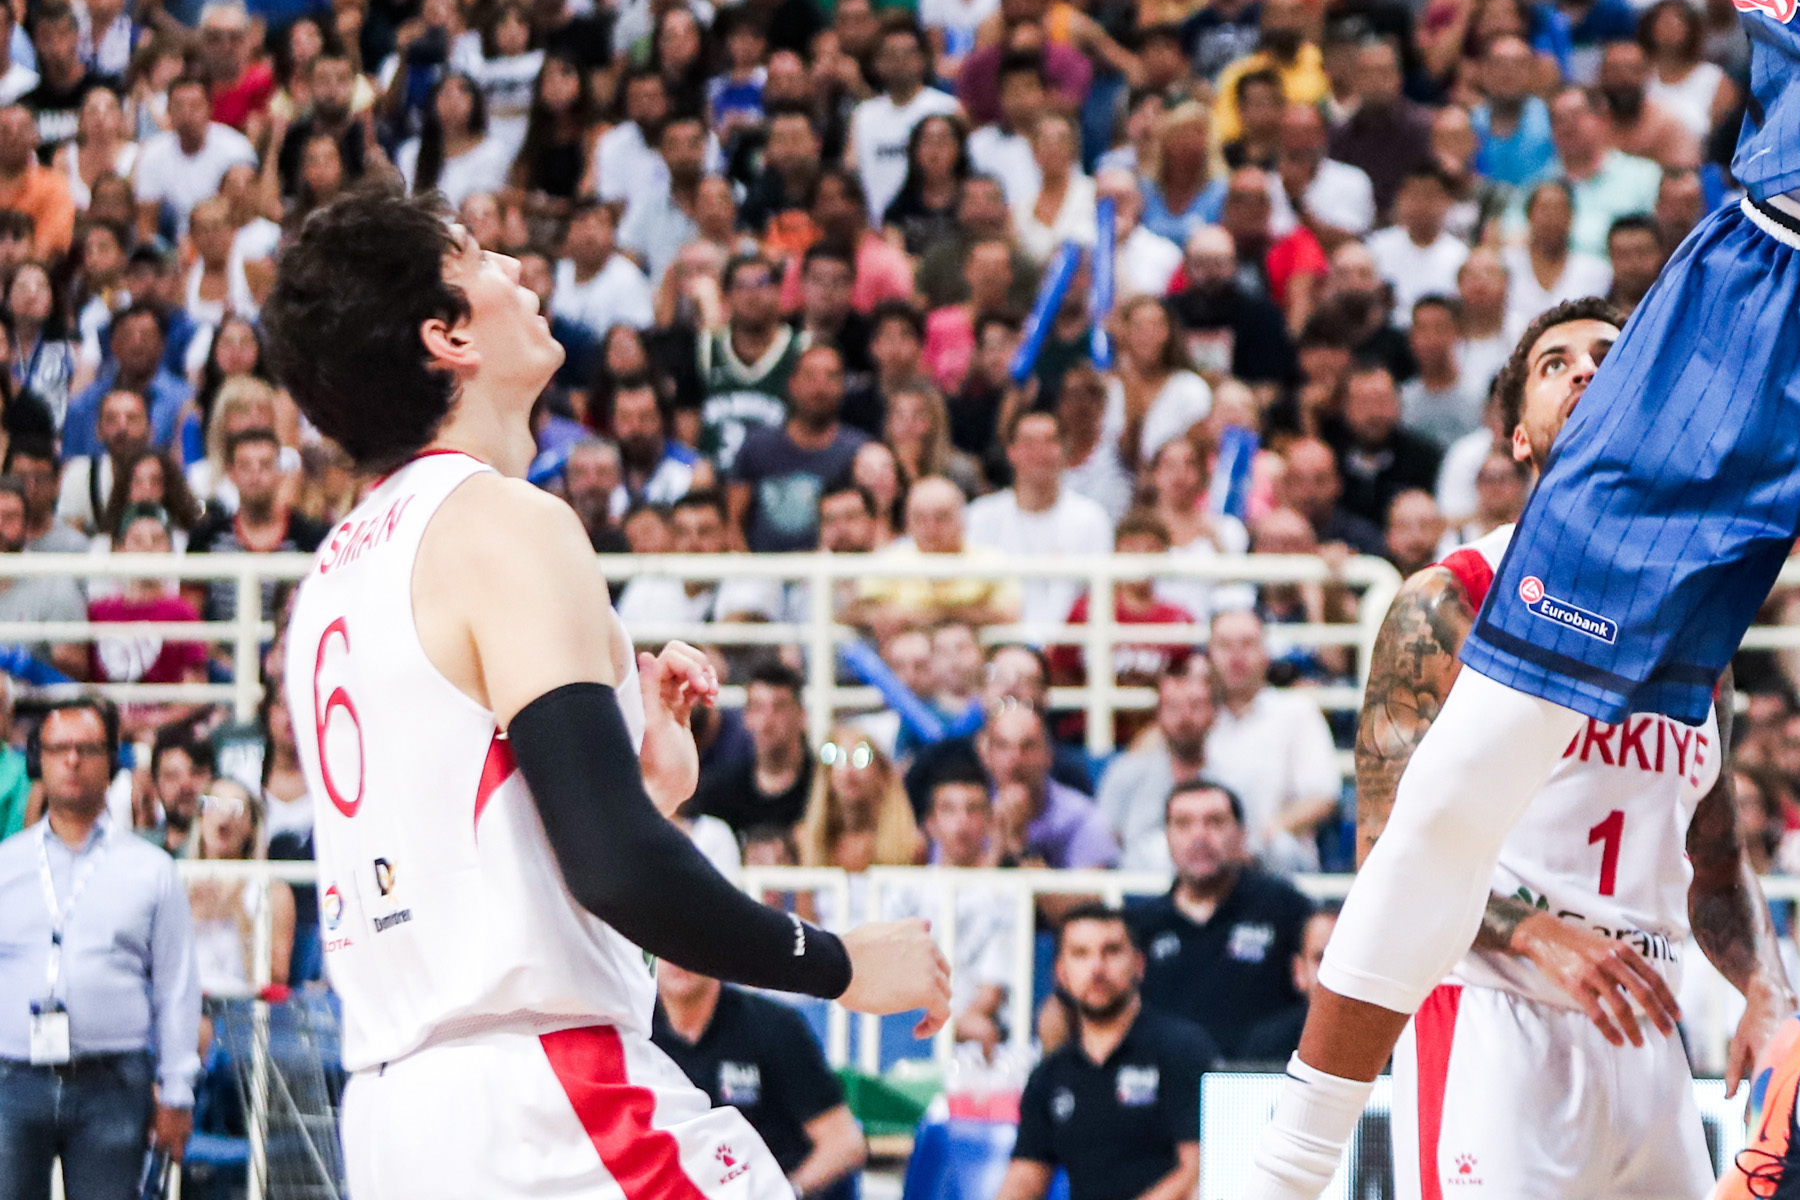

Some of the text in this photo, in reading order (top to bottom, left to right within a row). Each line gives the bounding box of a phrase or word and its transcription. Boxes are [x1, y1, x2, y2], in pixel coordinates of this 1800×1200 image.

[310, 493, 416, 575] SMAN
[1540, 599, 1609, 638] Eurobank
[314, 615, 365, 818] 6
[1561, 712, 1710, 789] RKİYE
[1588, 810, 1625, 896] 1
